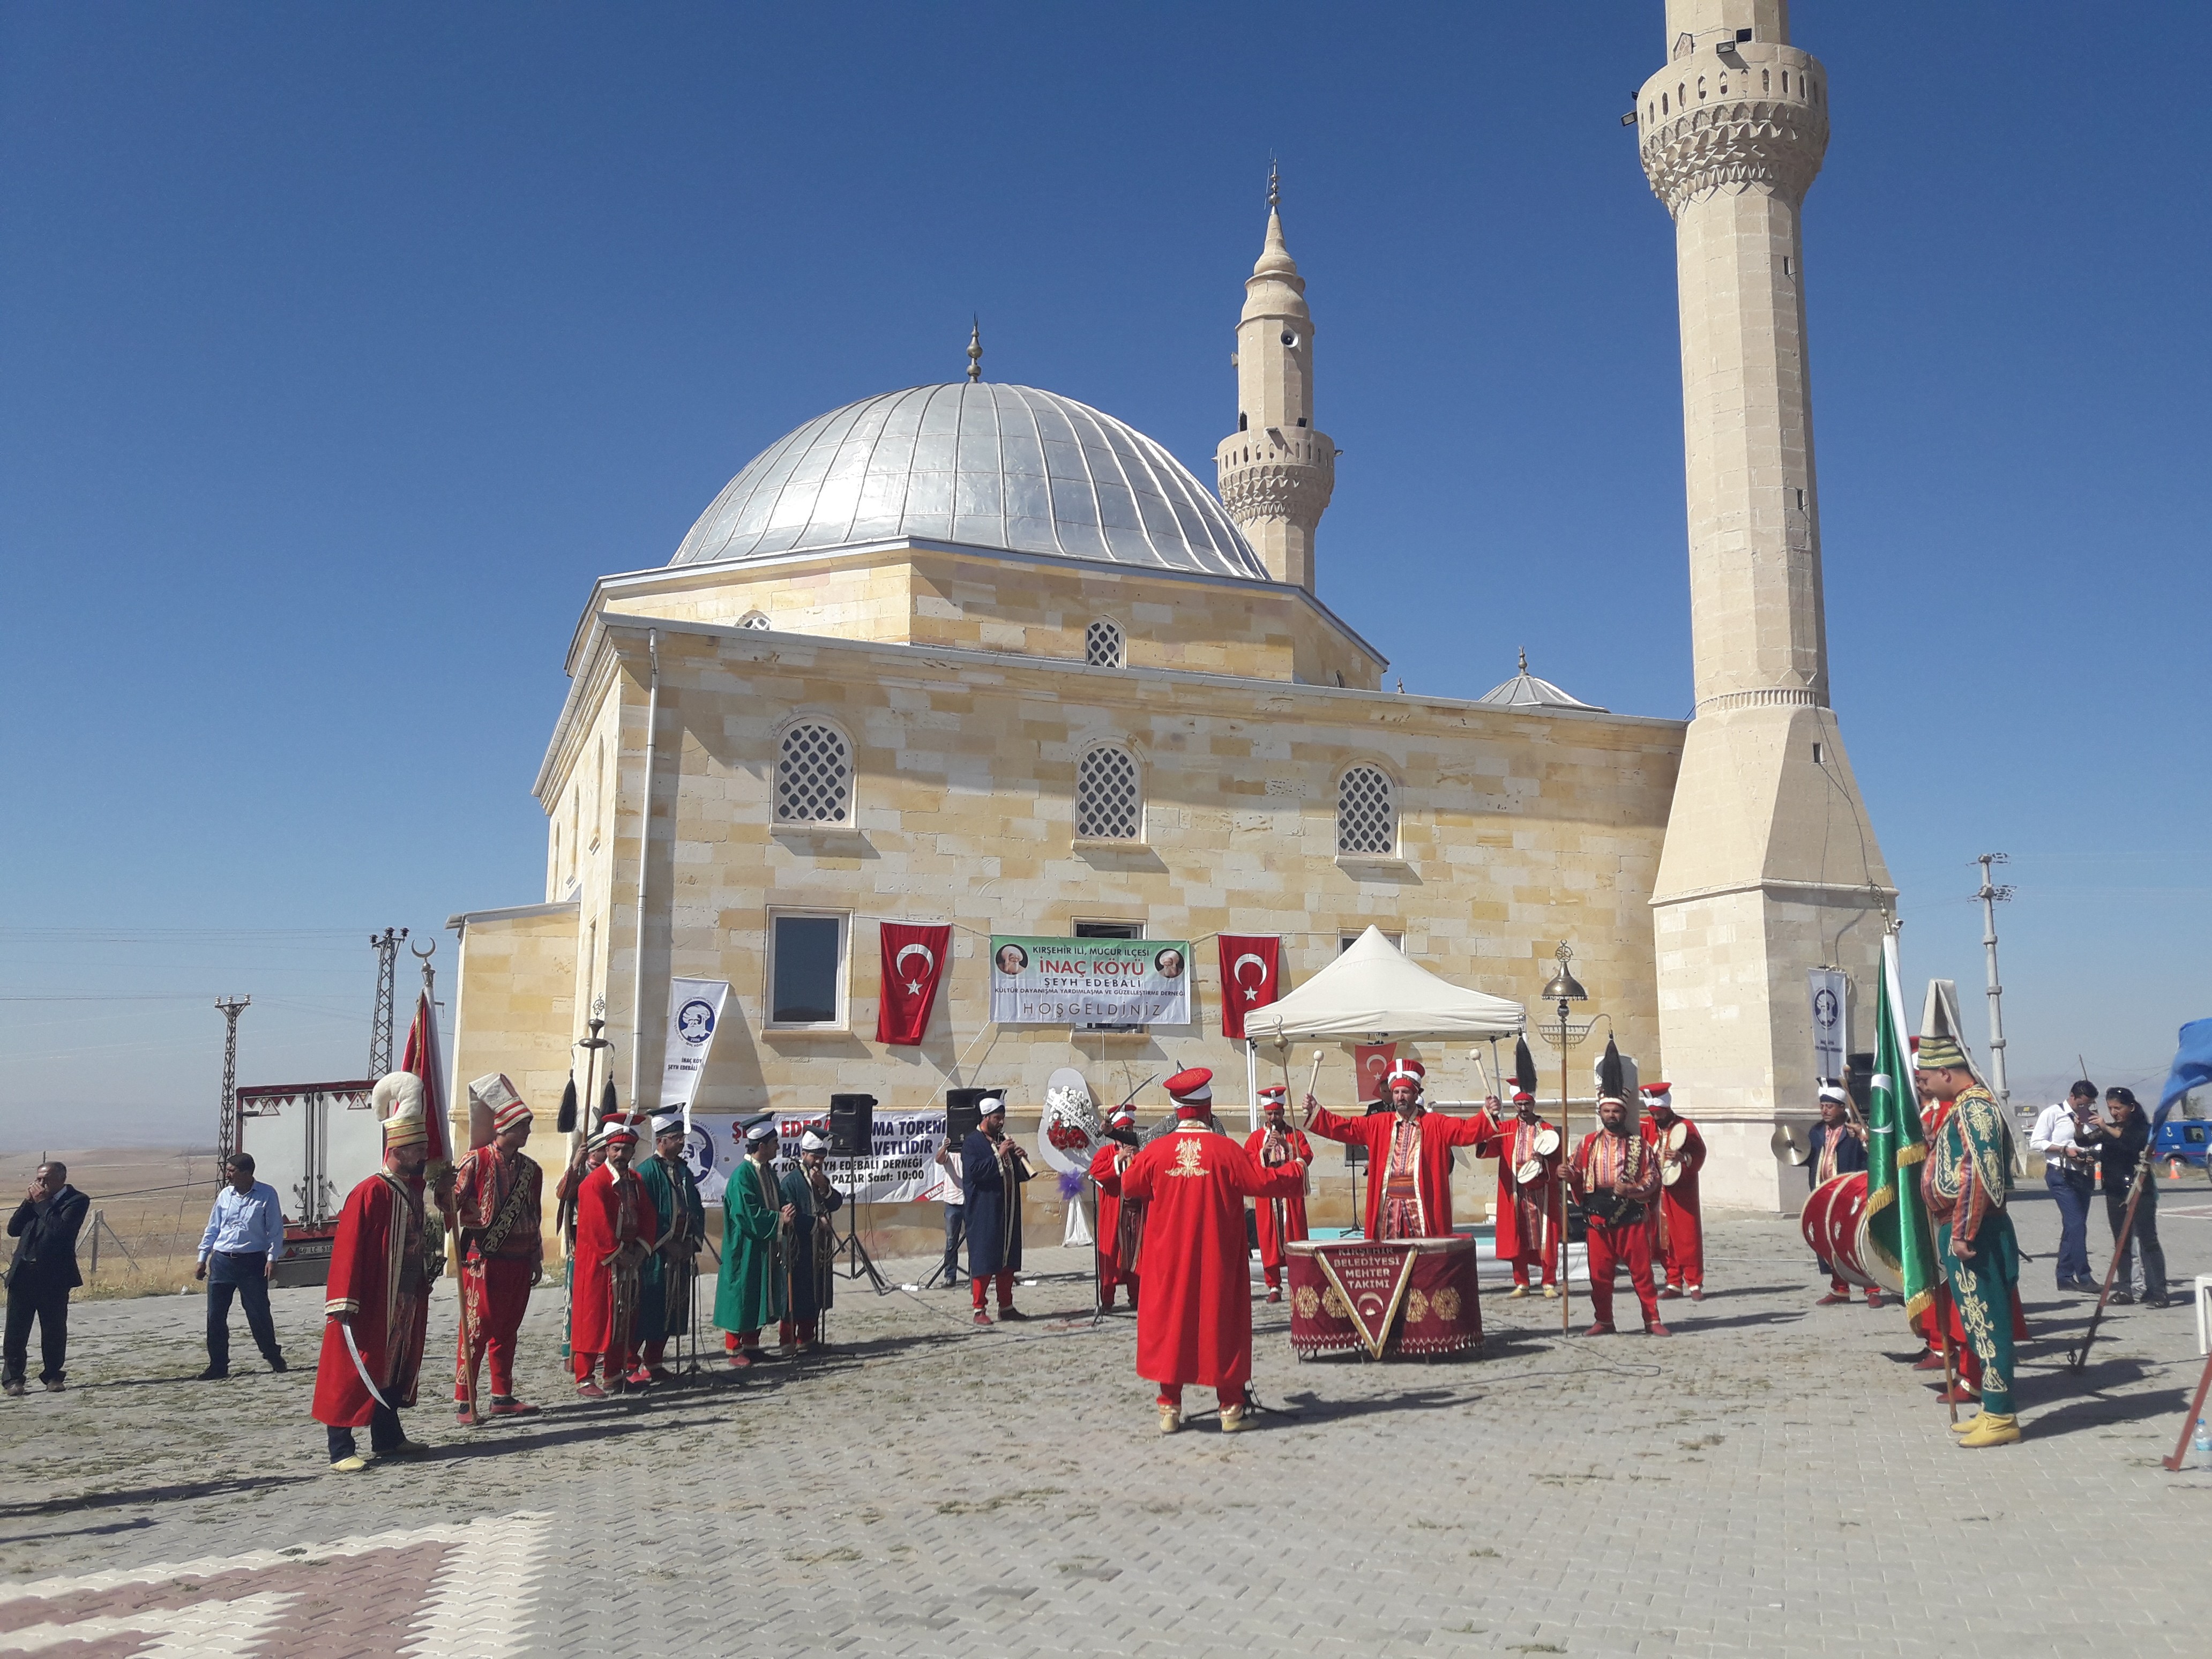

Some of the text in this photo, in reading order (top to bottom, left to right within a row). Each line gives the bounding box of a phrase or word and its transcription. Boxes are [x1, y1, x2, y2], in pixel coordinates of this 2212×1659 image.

[1033, 945, 1071, 955] KIRŞEHİR
[1089, 947, 1122, 955] MUCUR
[1124, 947, 1149, 958] İLÇESİ
[1040, 956, 1144, 978] İNAÇ KÖYÜ
[1044, 977, 1141, 988] ŞEYH EDEBALİ
[1024, 1001, 1160, 1018] HOŞGELDİNİZ
[872, 1120, 894, 1136] MA
[898, 1116, 947, 1135] TÖRENİ
[874, 1135, 933, 1156] VETLİDİR
[883, 1154, 923, 1169] DERNEĞİ
[832, 1170, 924, 1184] PAZAR Saat: 10:00
[1334, 1255, 1400, 1268] BELEDİYESİ
[1346, 1268, 1390, 1278] MEHTER
[1347, 1279, 1389, 1289] TAKIMI
